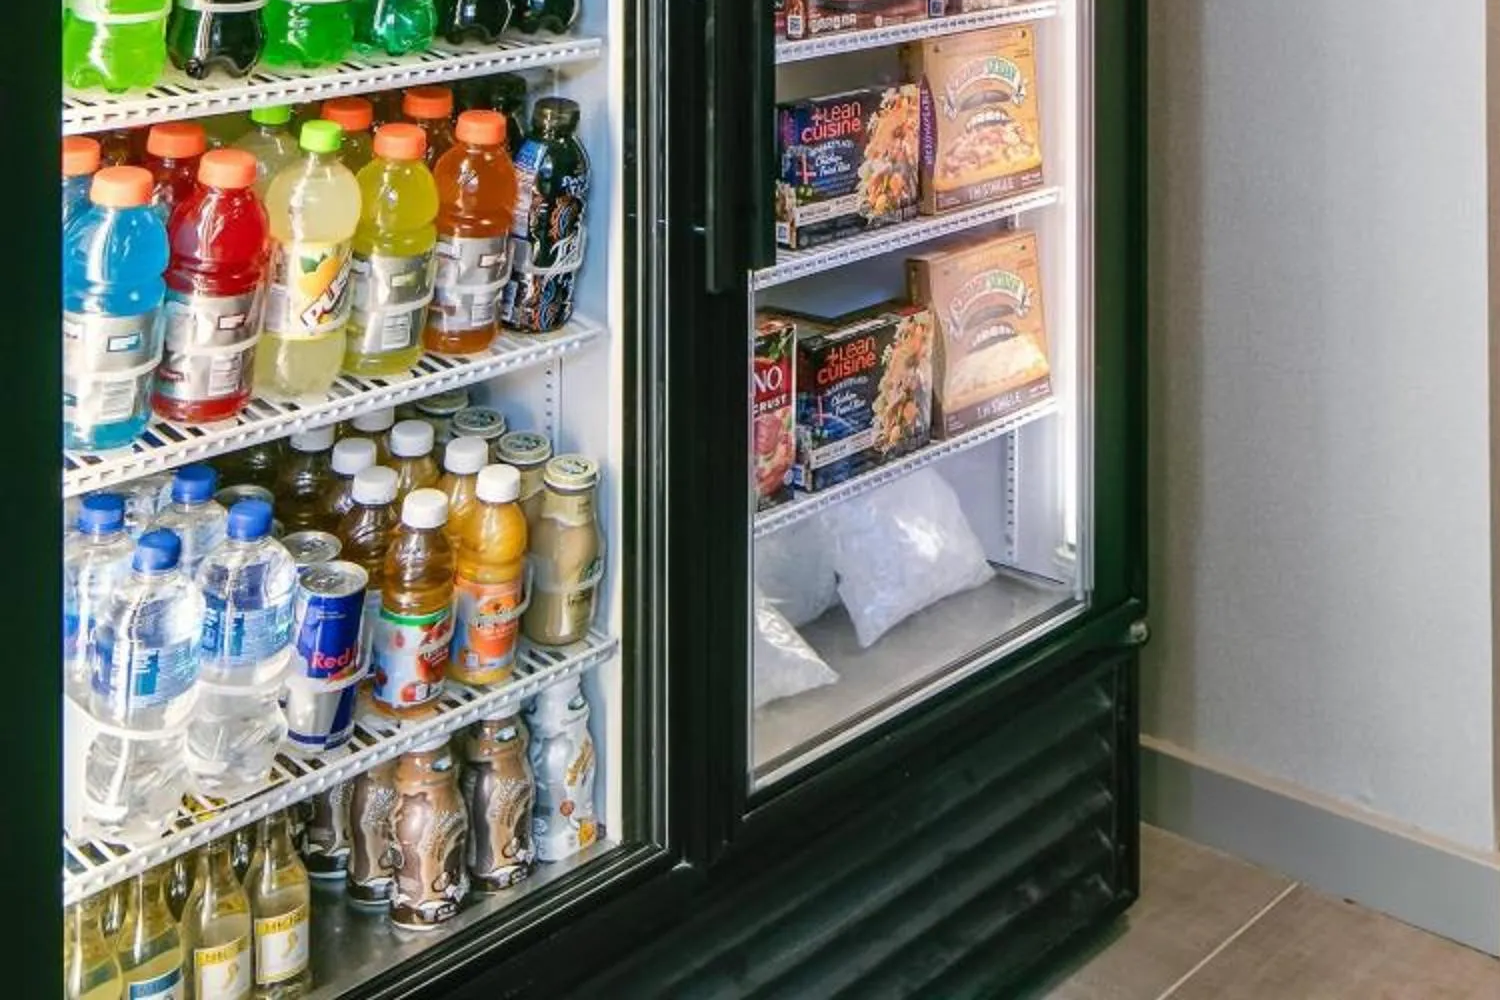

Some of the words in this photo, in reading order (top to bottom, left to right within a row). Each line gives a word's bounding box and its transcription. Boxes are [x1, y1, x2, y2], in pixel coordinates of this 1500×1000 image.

[824, 100, 862, 122] Lean
[801, 118, 863, 144] cuisine
[838, 333, 877, 359] Lean
[815, 349, 878, 386] cuisine
